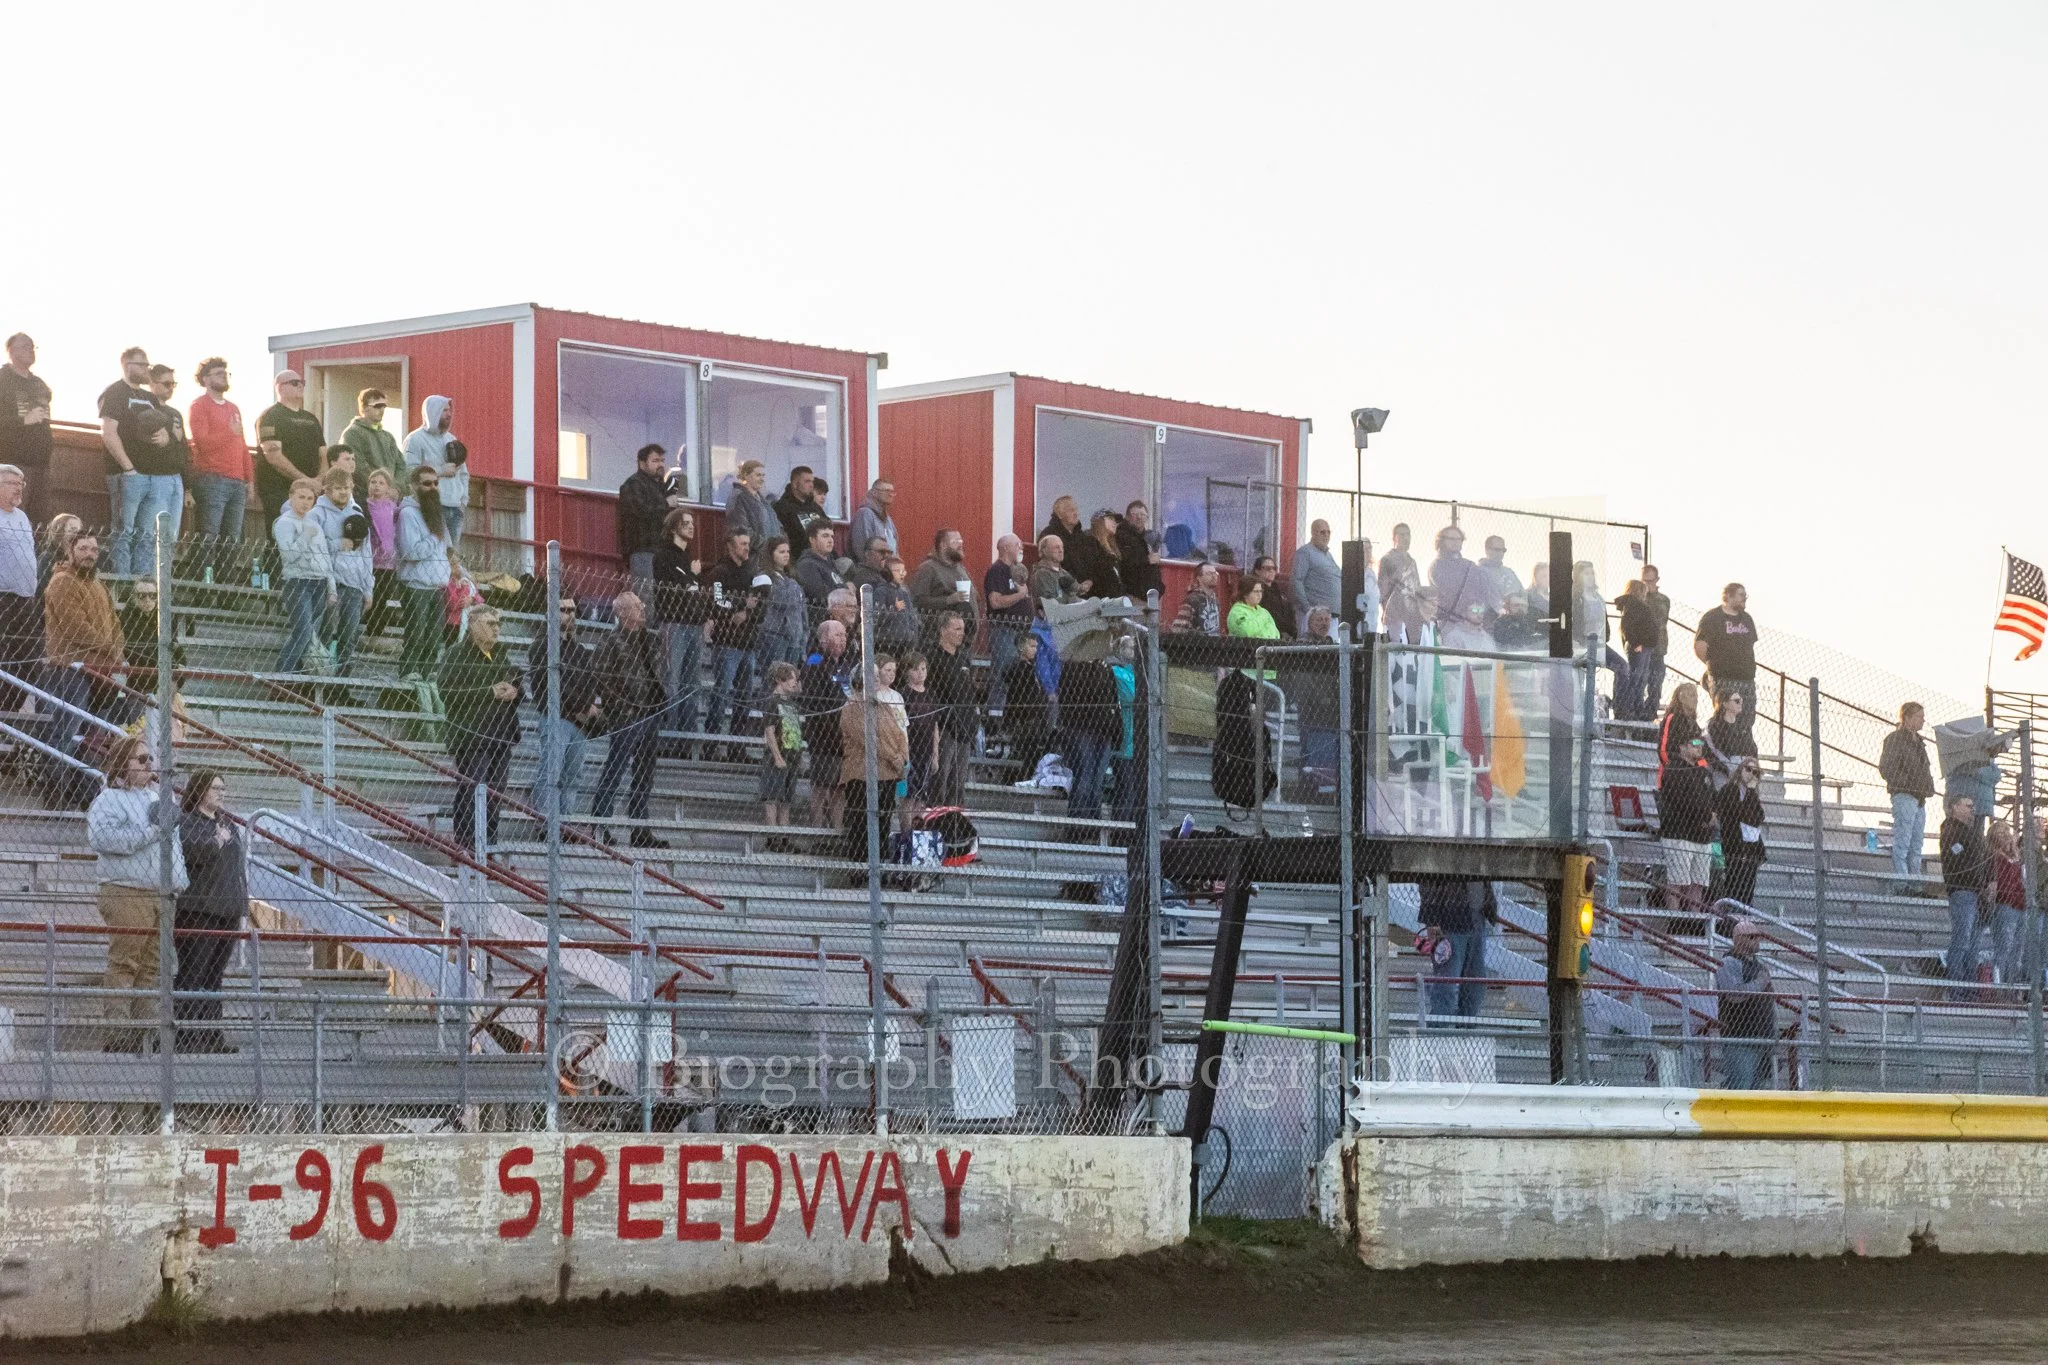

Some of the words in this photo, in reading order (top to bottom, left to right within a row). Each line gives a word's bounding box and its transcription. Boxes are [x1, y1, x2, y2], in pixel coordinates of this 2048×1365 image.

[702, 364, 710, 378] 8
[1158, 428, 1165, 441] 9
[199, 1146, 398, 1248] I-96
[499, 1145, 972, 1244] SPEEDWAY
